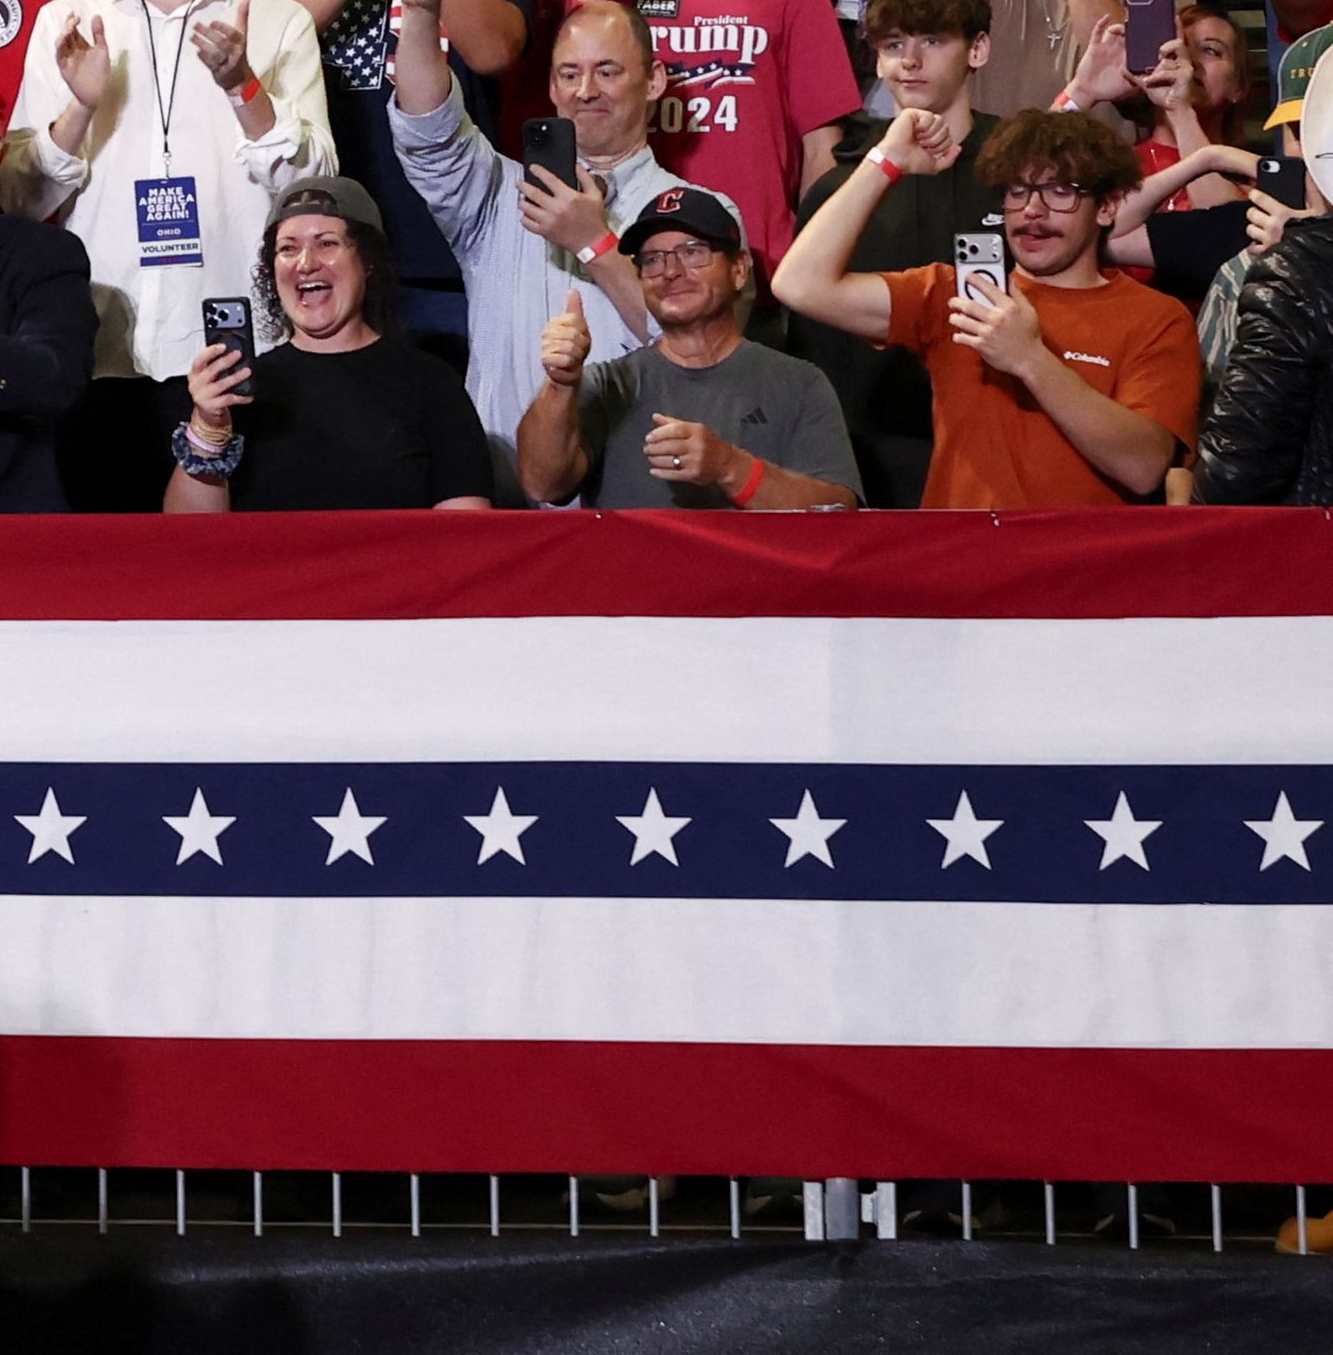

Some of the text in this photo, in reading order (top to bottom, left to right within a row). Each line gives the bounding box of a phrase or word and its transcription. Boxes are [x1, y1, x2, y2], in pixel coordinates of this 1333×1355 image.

[693, 15, 749, 26] President
[649, 24, 769, 65] rump
[148, 186, 184, 197] MAKE
[138, 193, 195, 207] AMERICA
[656, 189, 685, 214] C
[146, 203, 187, 214] GREAT
[145, 210, 190, 222] AGAIN!
[156, 228, 182, 237] OHIO
[141, 242, 199, 254] VOLUNTEER
